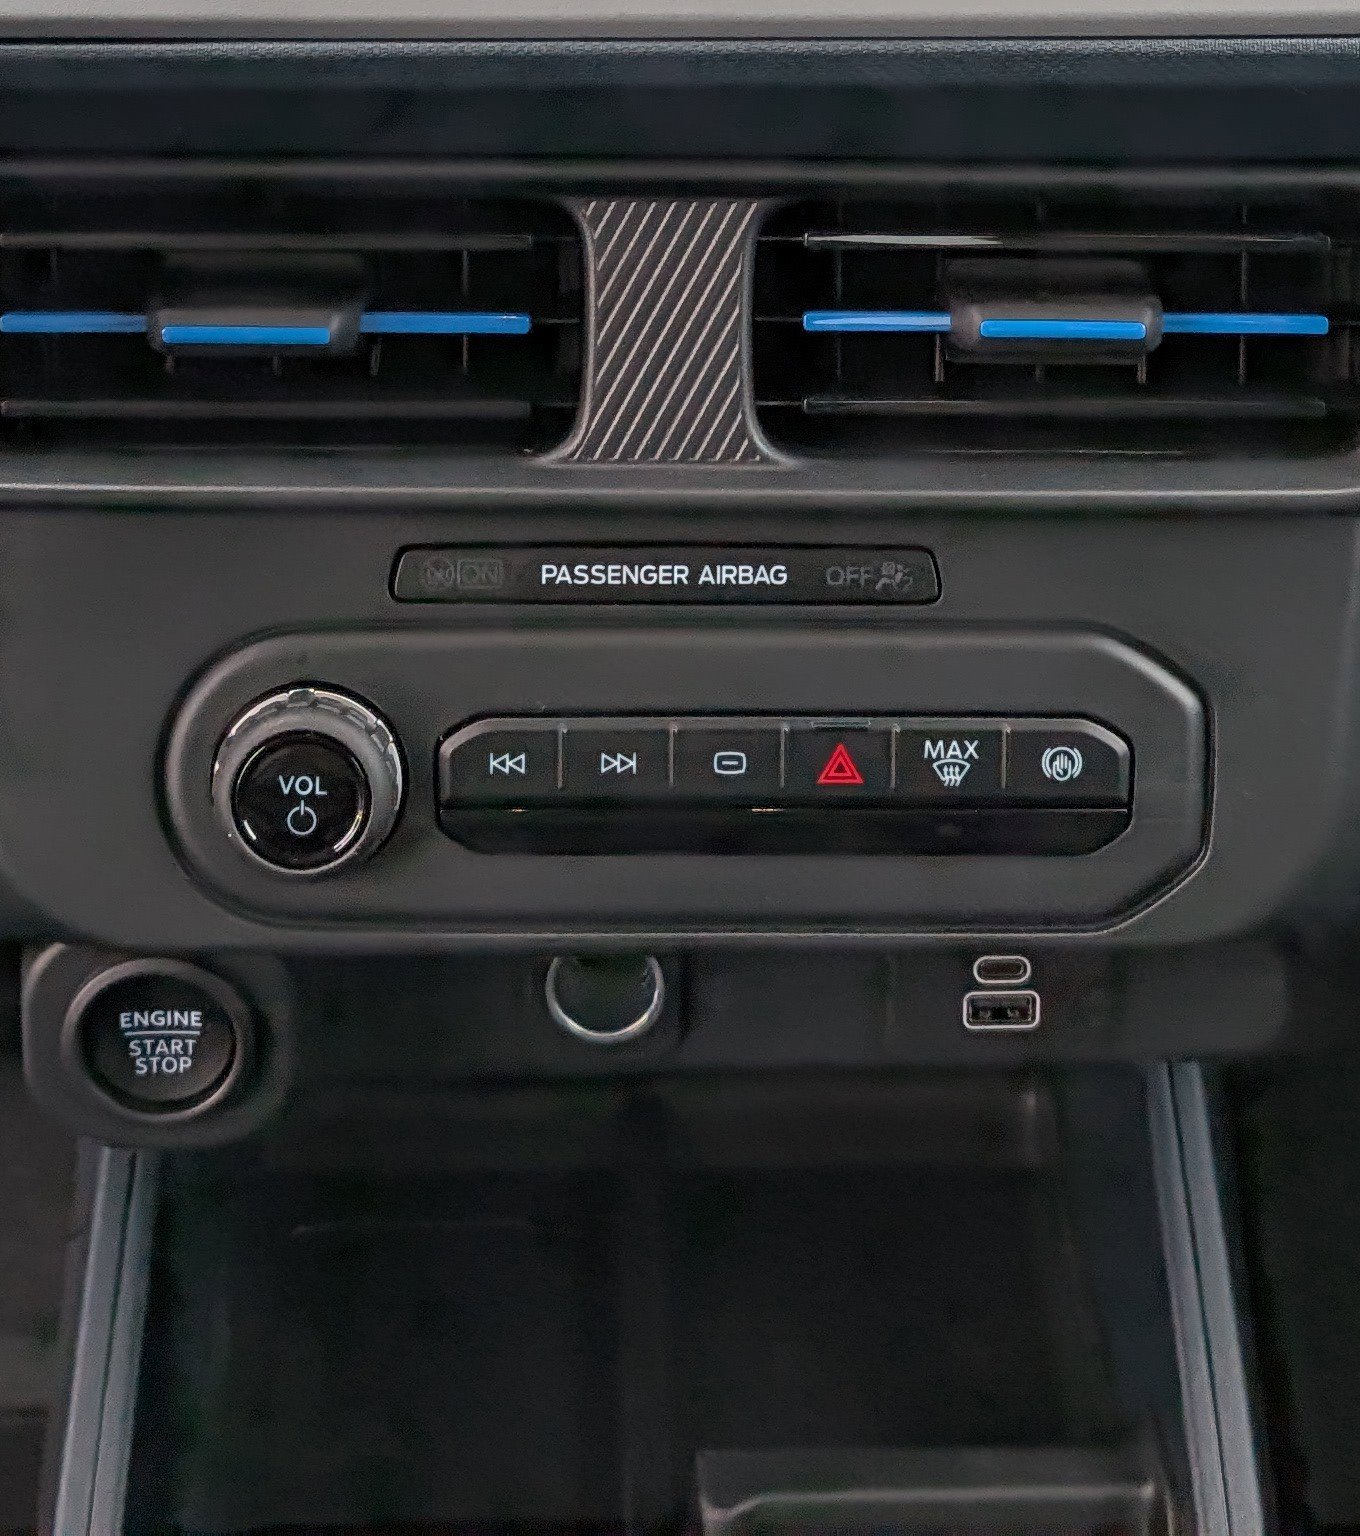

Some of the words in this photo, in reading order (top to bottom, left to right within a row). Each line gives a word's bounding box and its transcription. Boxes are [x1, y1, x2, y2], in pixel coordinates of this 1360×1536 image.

[541, 564, 690, 585] PASSENGER
[697, 564, 788, 586] AIRBAG
[923, 739, 980, 761] MAX
[278, 774, 328, 797] VOL
[120, 1010, 203, 1029] ENGINE
[129, 1039, 197, 1057] START
[135, 1056, 192, 1075] STOP
